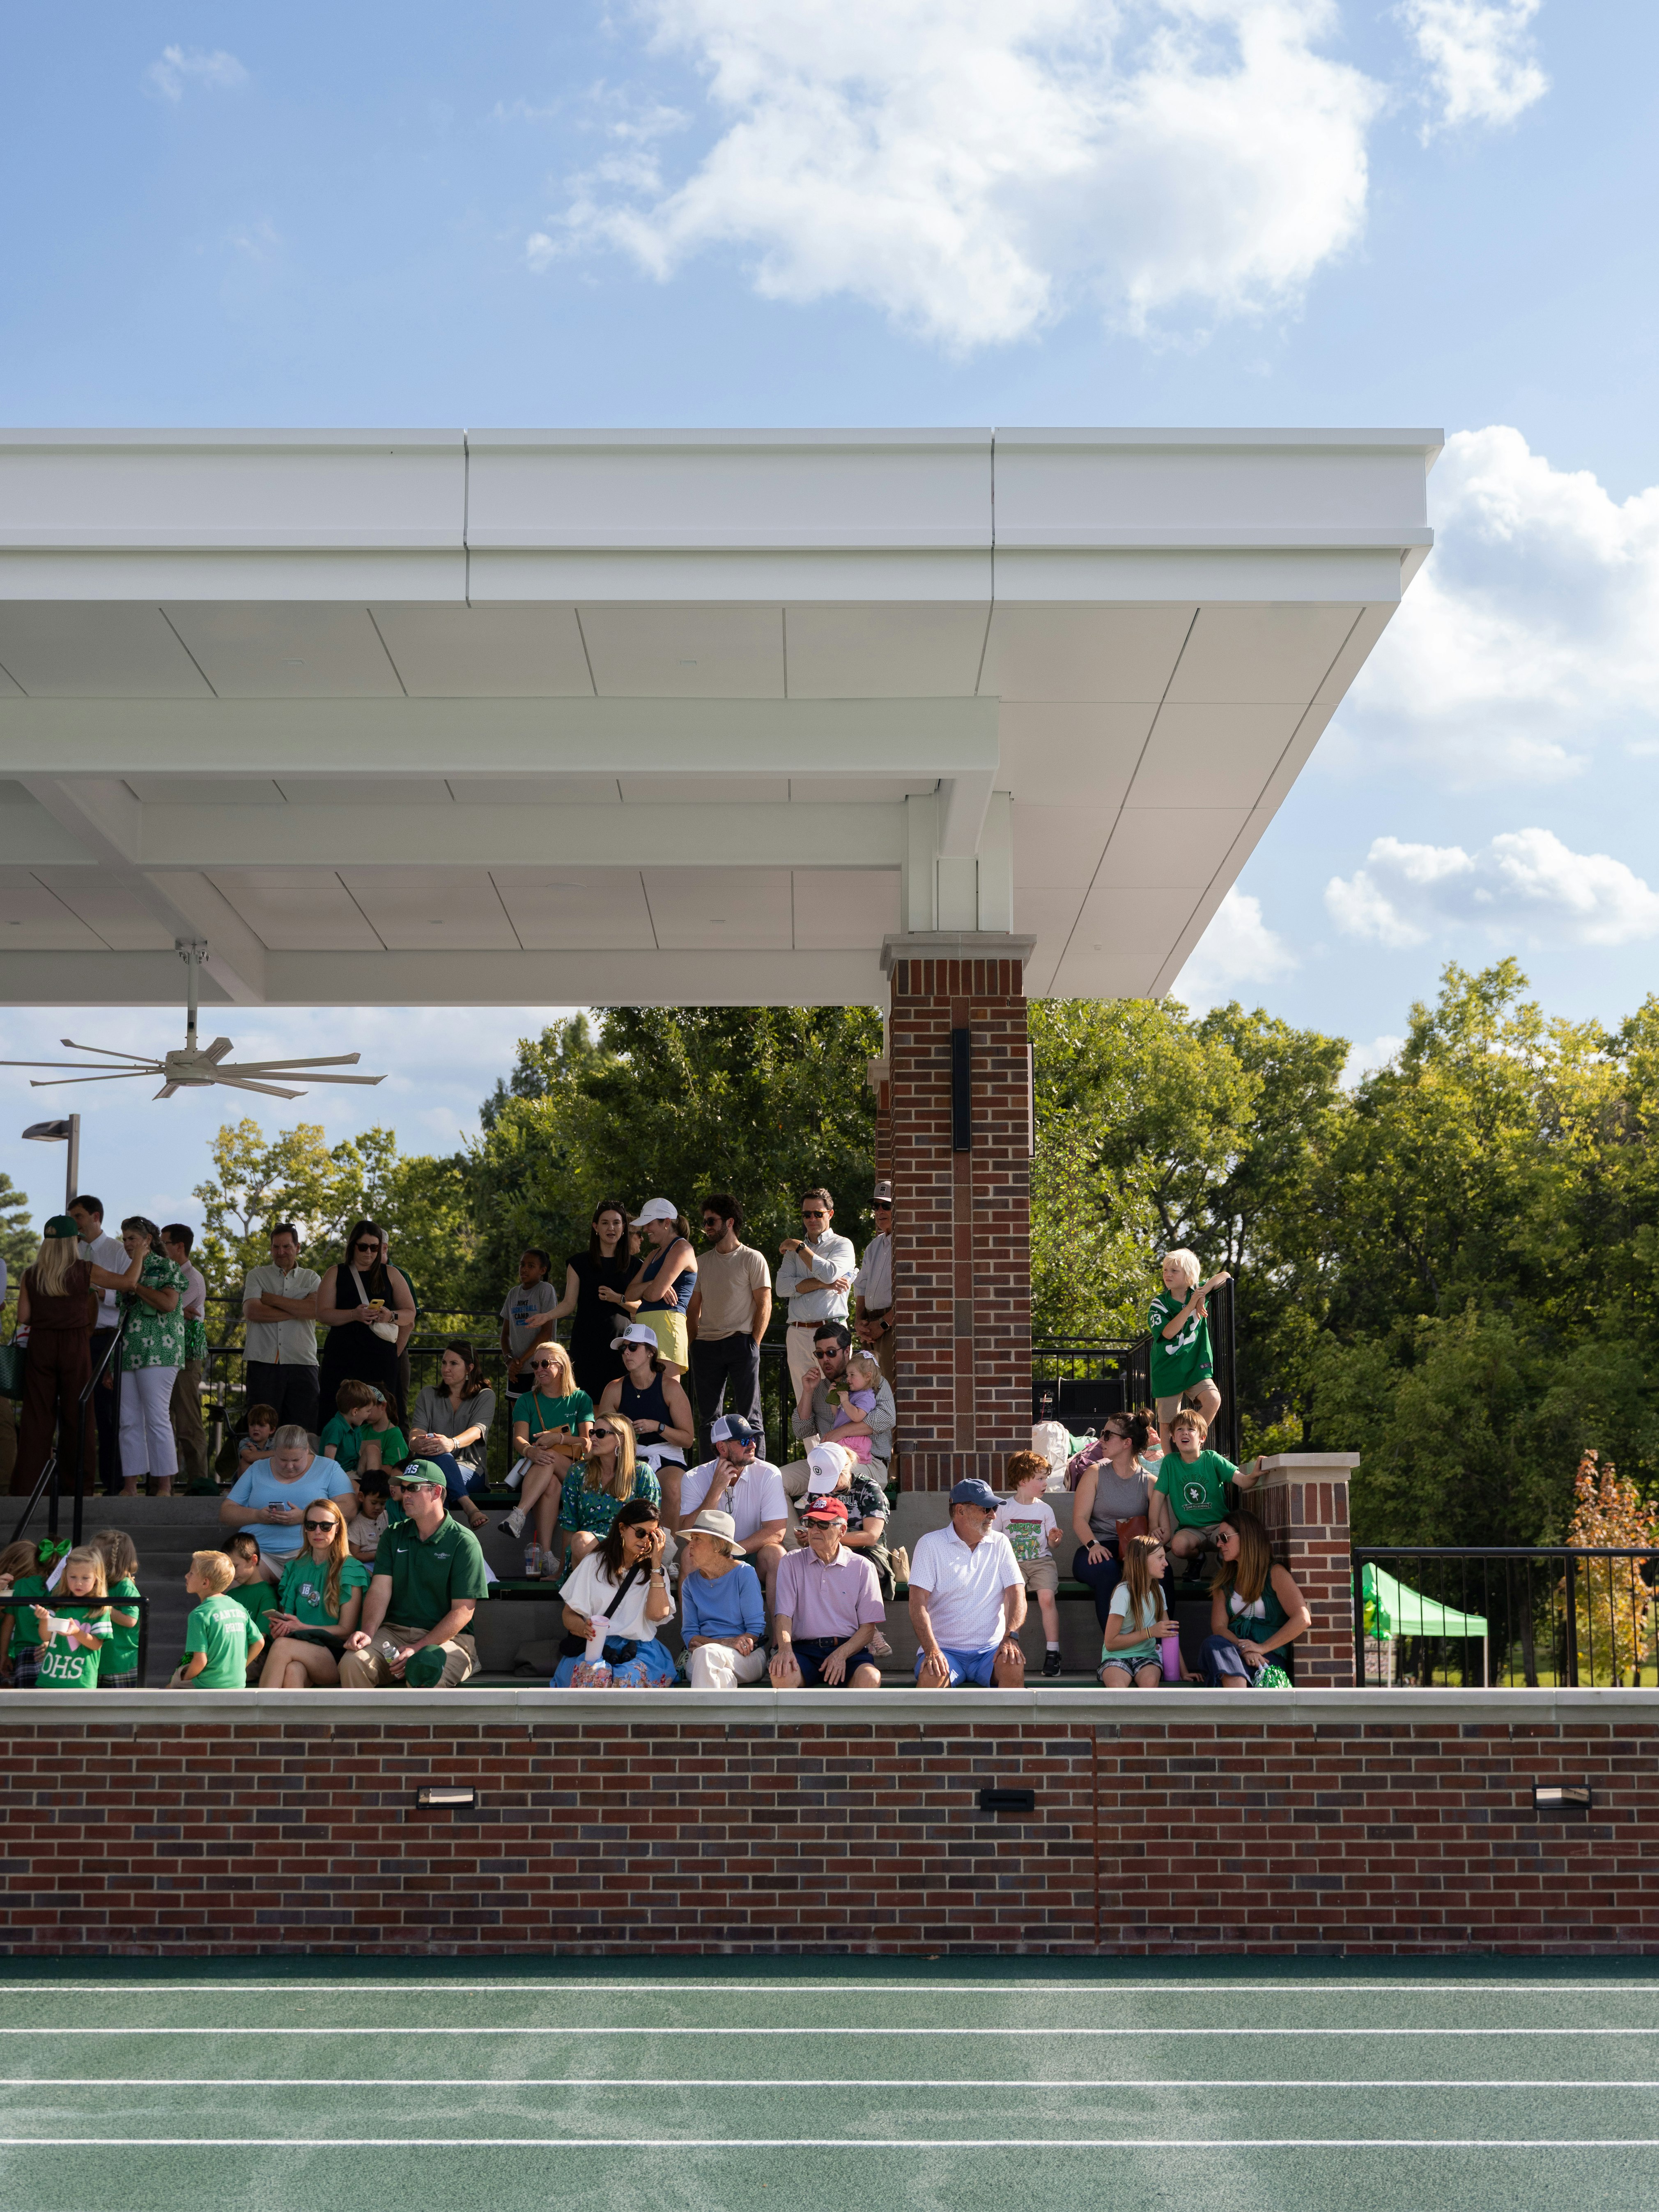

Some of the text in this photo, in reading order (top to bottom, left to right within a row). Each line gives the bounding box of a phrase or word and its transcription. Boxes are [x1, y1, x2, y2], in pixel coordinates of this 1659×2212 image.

[1150, 1314, 1162, 1328] 33
[403, 1464, 419, 1476] HS
[302, 1586, 310, 1594] 18
[42, 1652, 85, 1679] OHS
